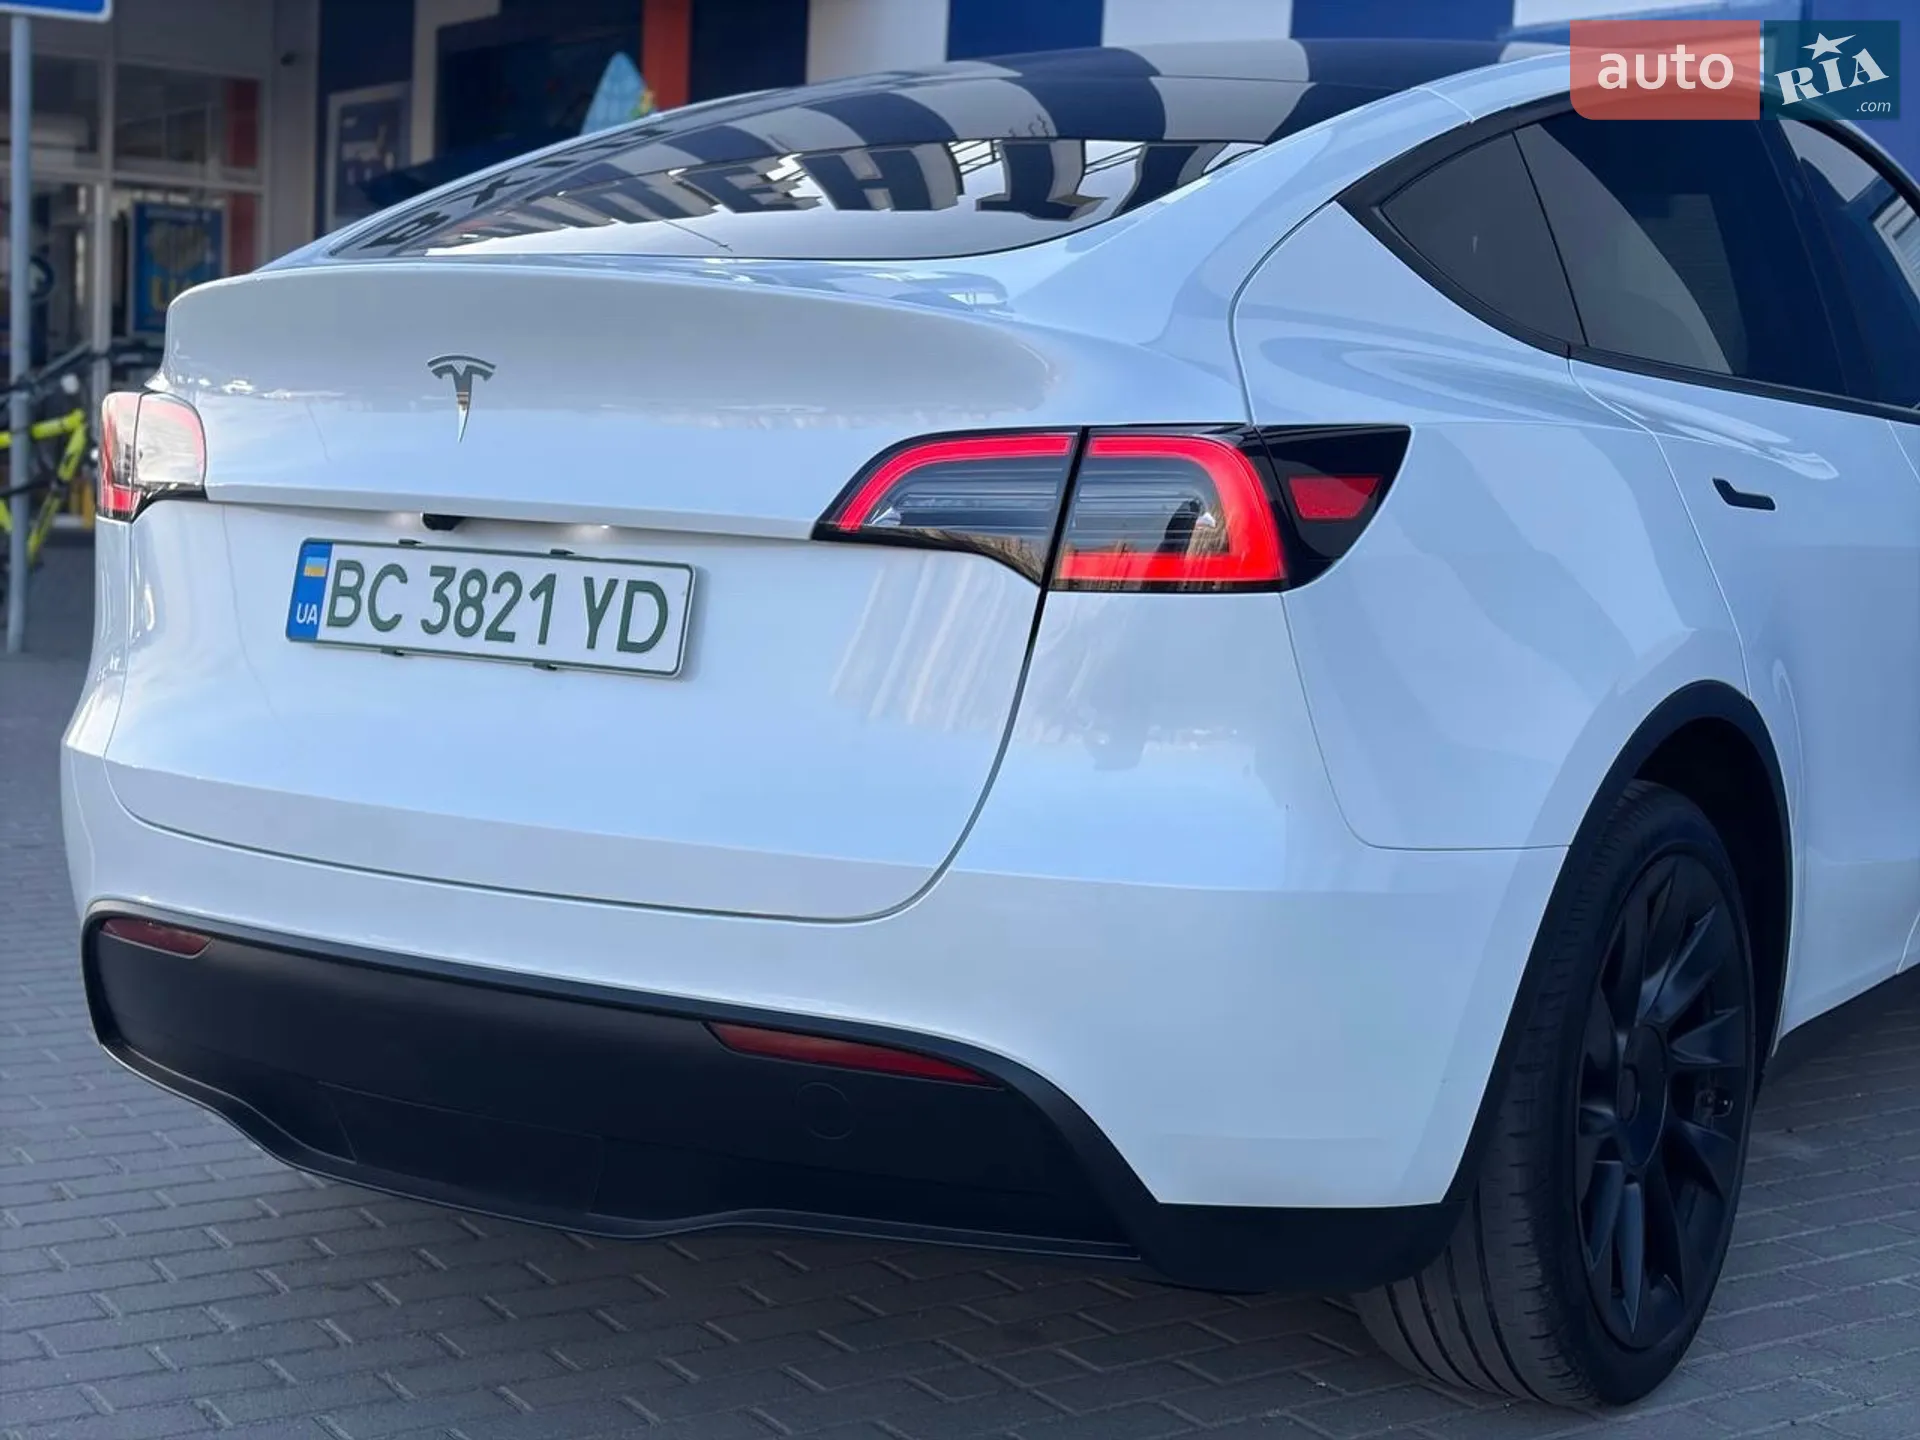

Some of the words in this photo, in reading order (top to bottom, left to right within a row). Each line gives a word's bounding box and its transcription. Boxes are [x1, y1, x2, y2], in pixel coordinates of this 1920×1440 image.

[296, 604, 318, 625] UA
[325, 558, 409, 632] BC
[419, 564, 558, 646] 3821
[582, 575, 669, 654] YD
